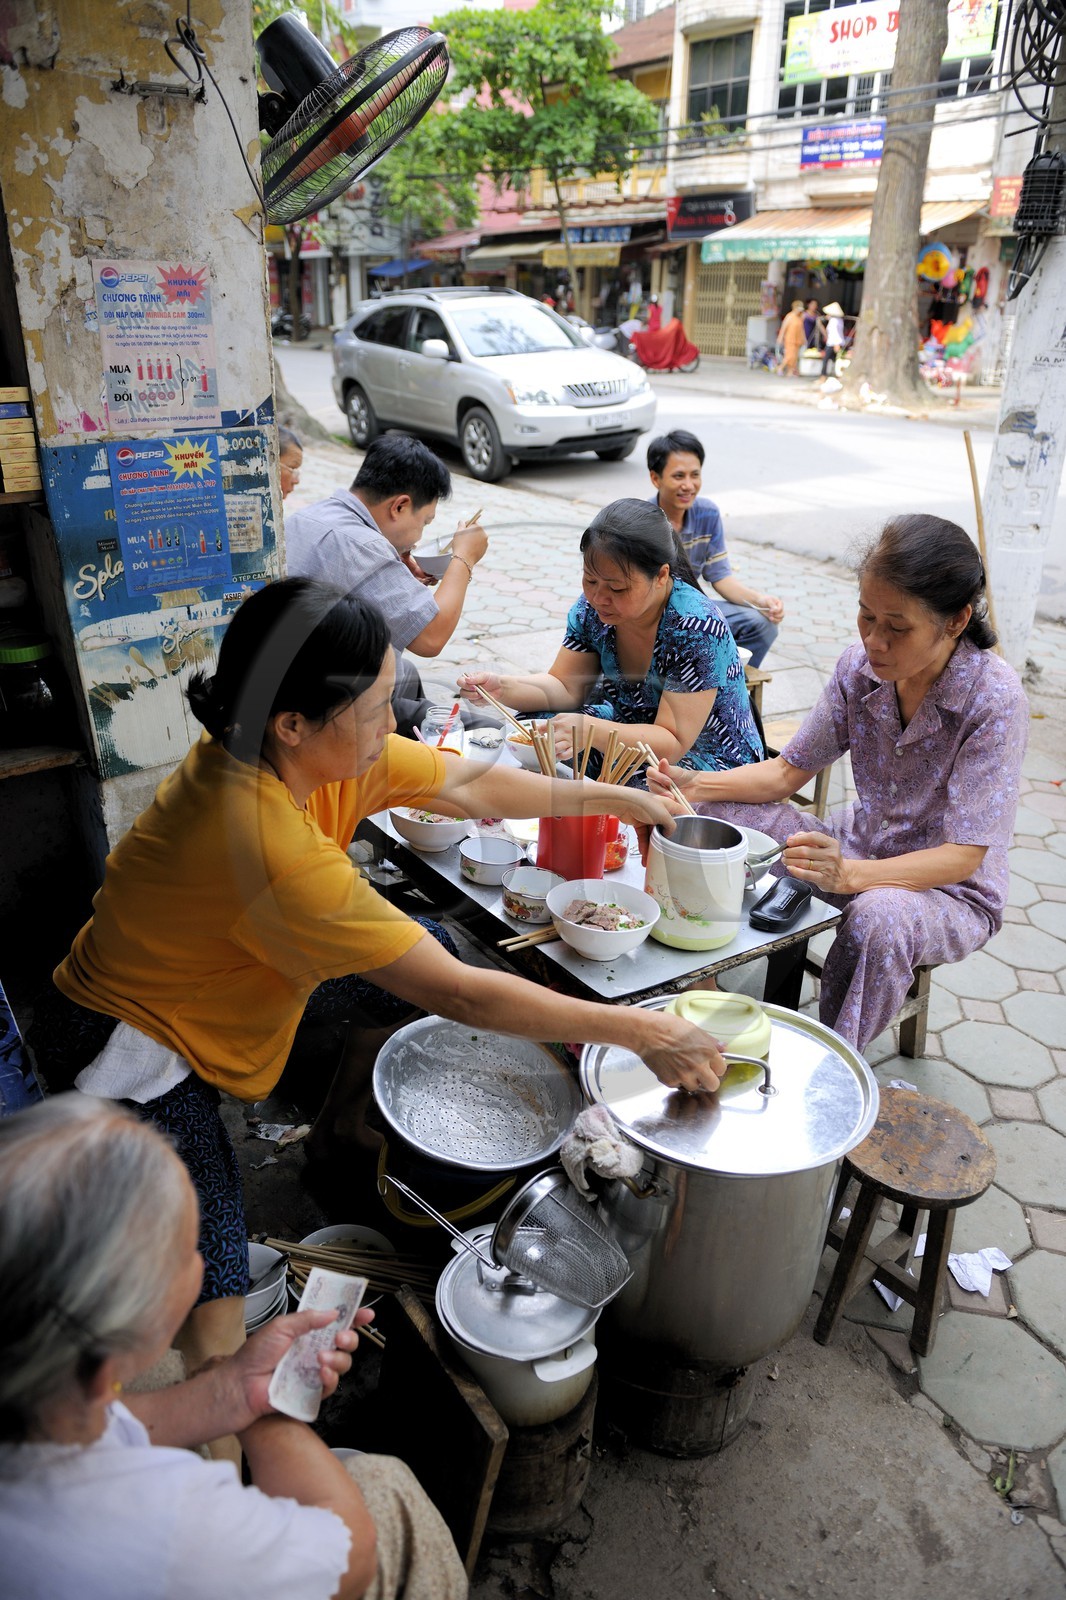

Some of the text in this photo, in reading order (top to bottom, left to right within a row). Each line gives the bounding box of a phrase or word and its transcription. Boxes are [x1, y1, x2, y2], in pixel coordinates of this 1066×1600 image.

[829, 15, 878, 43] SHOP
[119, 273, 149, 282] PEPSI
[102, 291, 162, 302] CHƯƠNG TRÌNH
[130, 311, 145, 319] CHAI
[109, 365, 131, 374] MUA
[113, 388, 133, 402] ĐỔI
[135, 450, 164, 460] PEPSI
[174, 449, 204, 461] KHUYẾN
[183, 460, 198, 469] MÃI
[118, 468, 170, 481] CHƯƠNG TRÌNH
[127, 535, 146, 545] MUA
[132, 557, 149, 571] ĐỔI
[224, 592, 243, 602] XSMB
